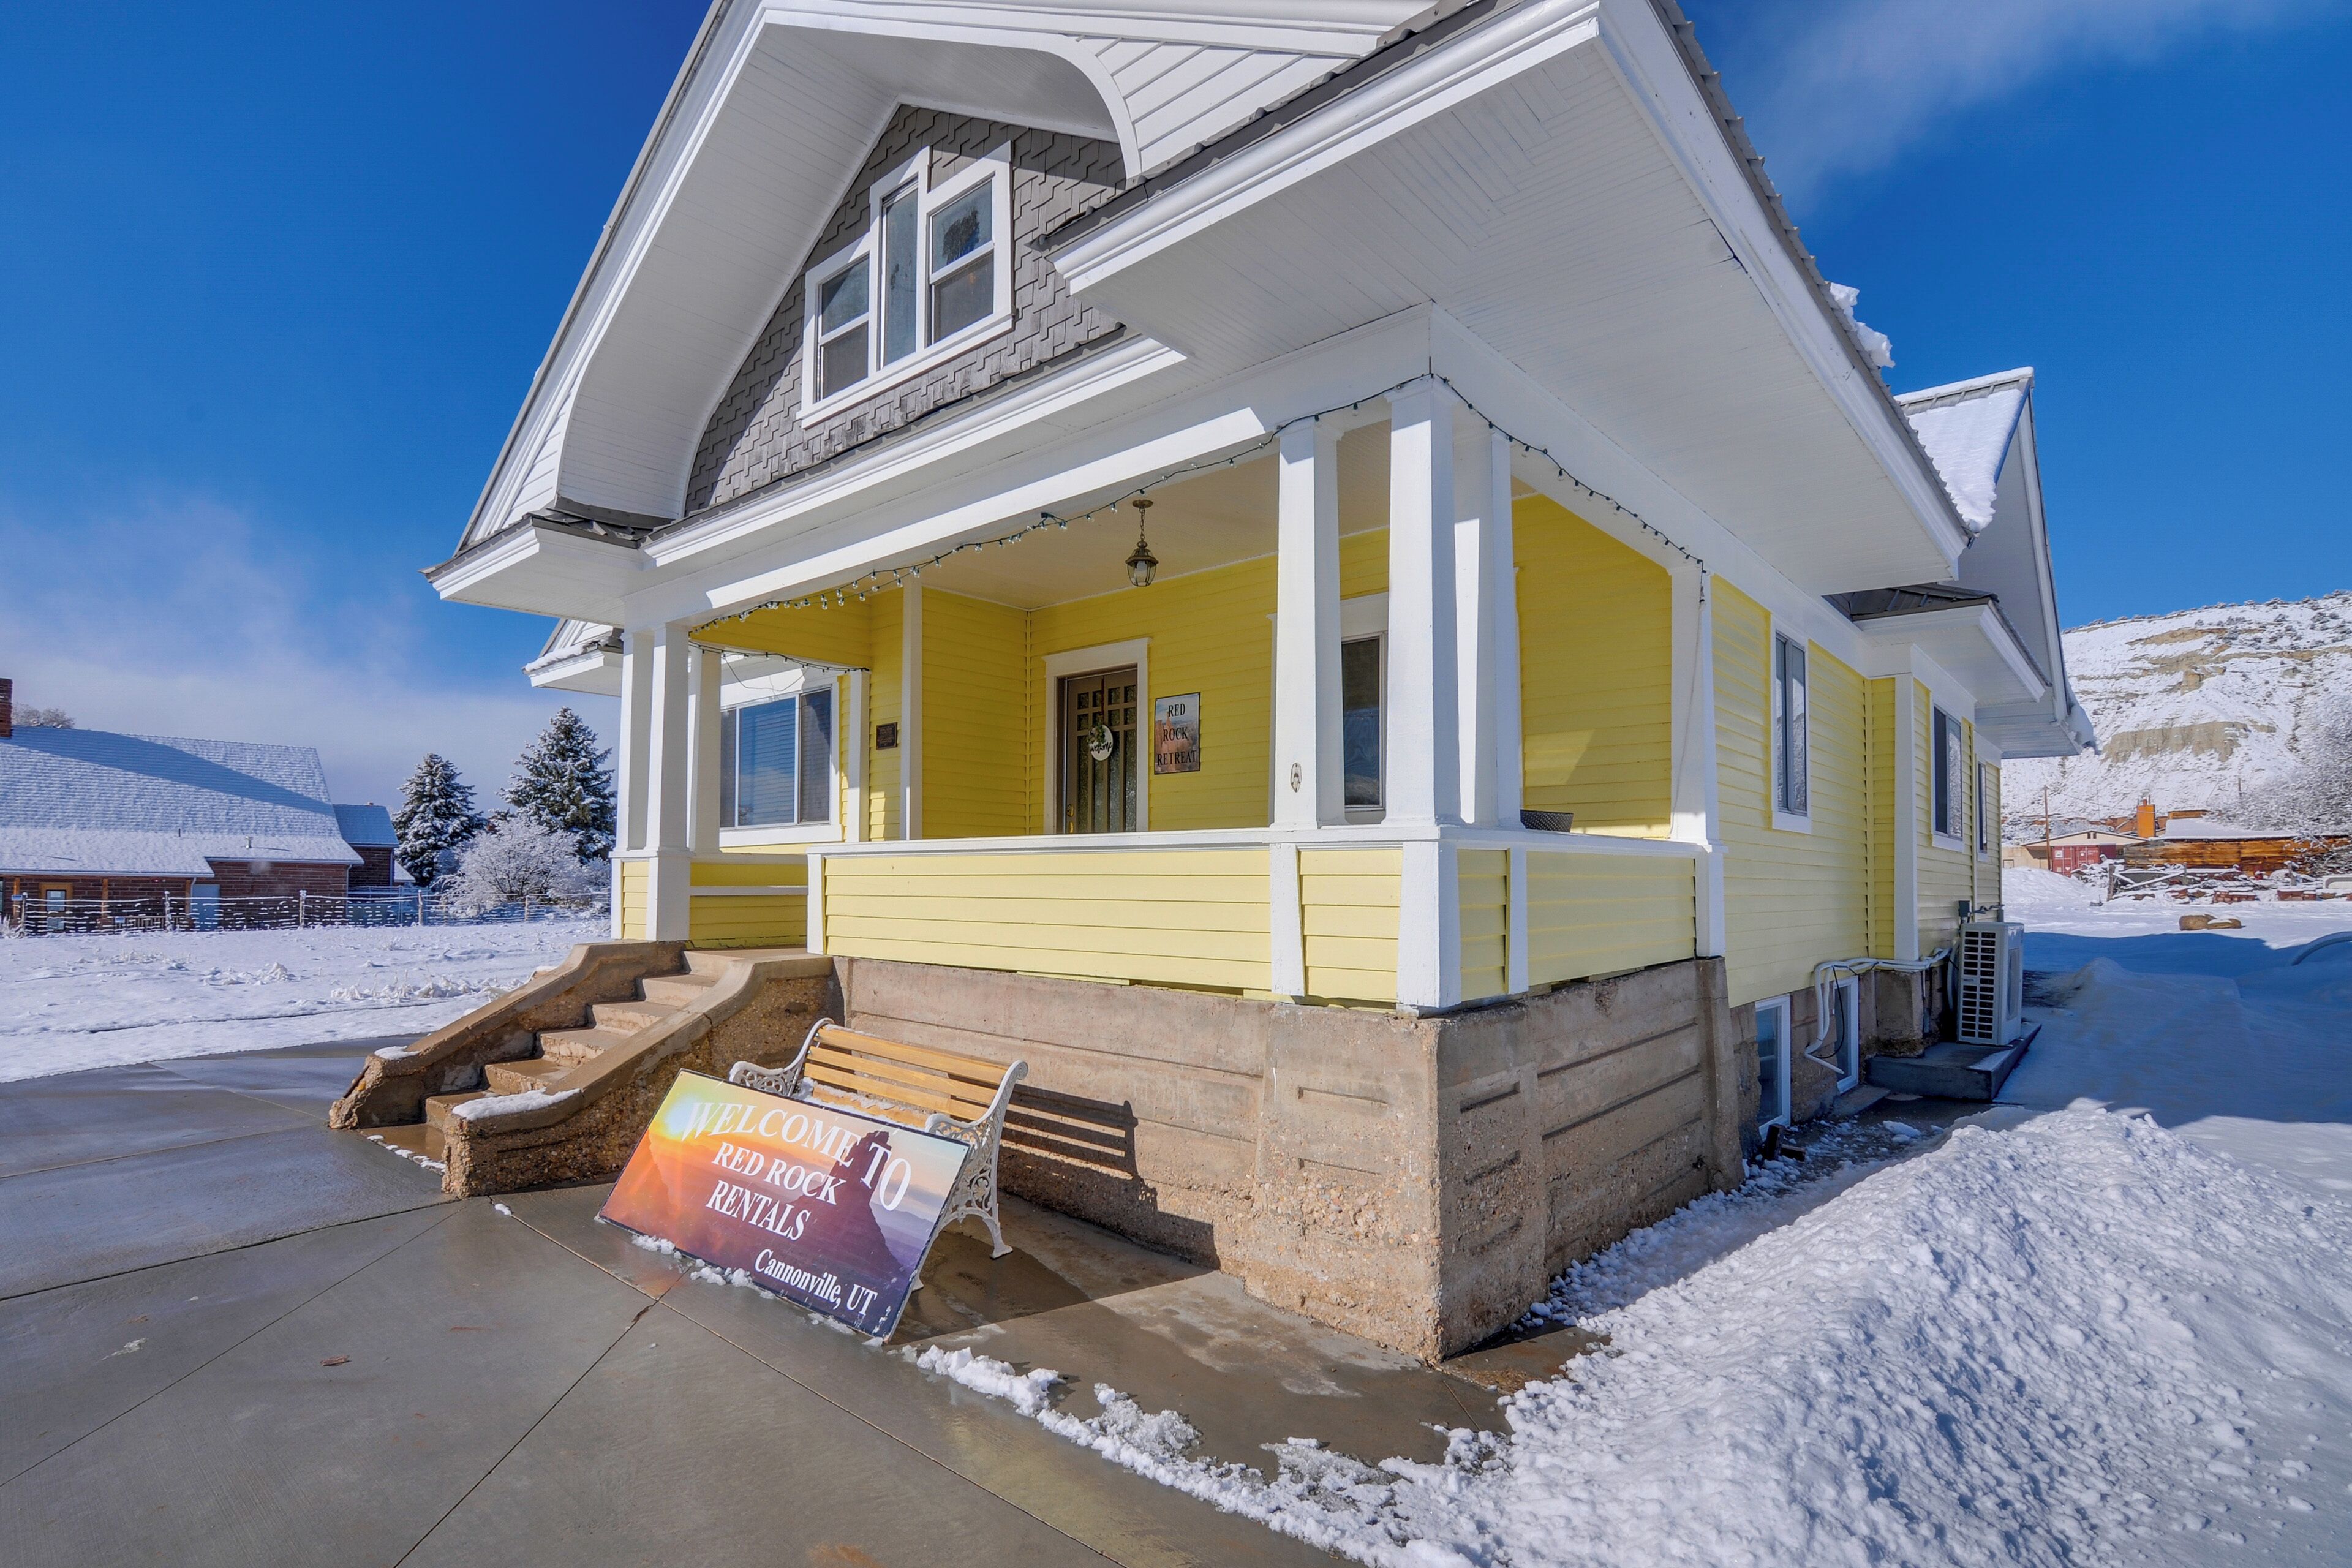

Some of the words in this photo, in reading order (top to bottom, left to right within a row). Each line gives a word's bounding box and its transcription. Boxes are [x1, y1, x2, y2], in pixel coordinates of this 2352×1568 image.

[1169, 703, 1186, 717] RED
[1090, 741, 1113, 753] welcome
[1163, 727, 1188, 742] ROCK
[1157, 750, 1197, 766] RETREAT
[680, 1102, 861, 1167] WELCOME
[861, 1142, 911, 1211] TO
[712, 1142, 765, 1177] RED
[764, 1158, 847, 1205] ROCK
[706, 1180, 812, 1241] RENTALS
[754, 1248, 841, 1309] Cannonville,
[846, 1284, 878, 1316] UT
